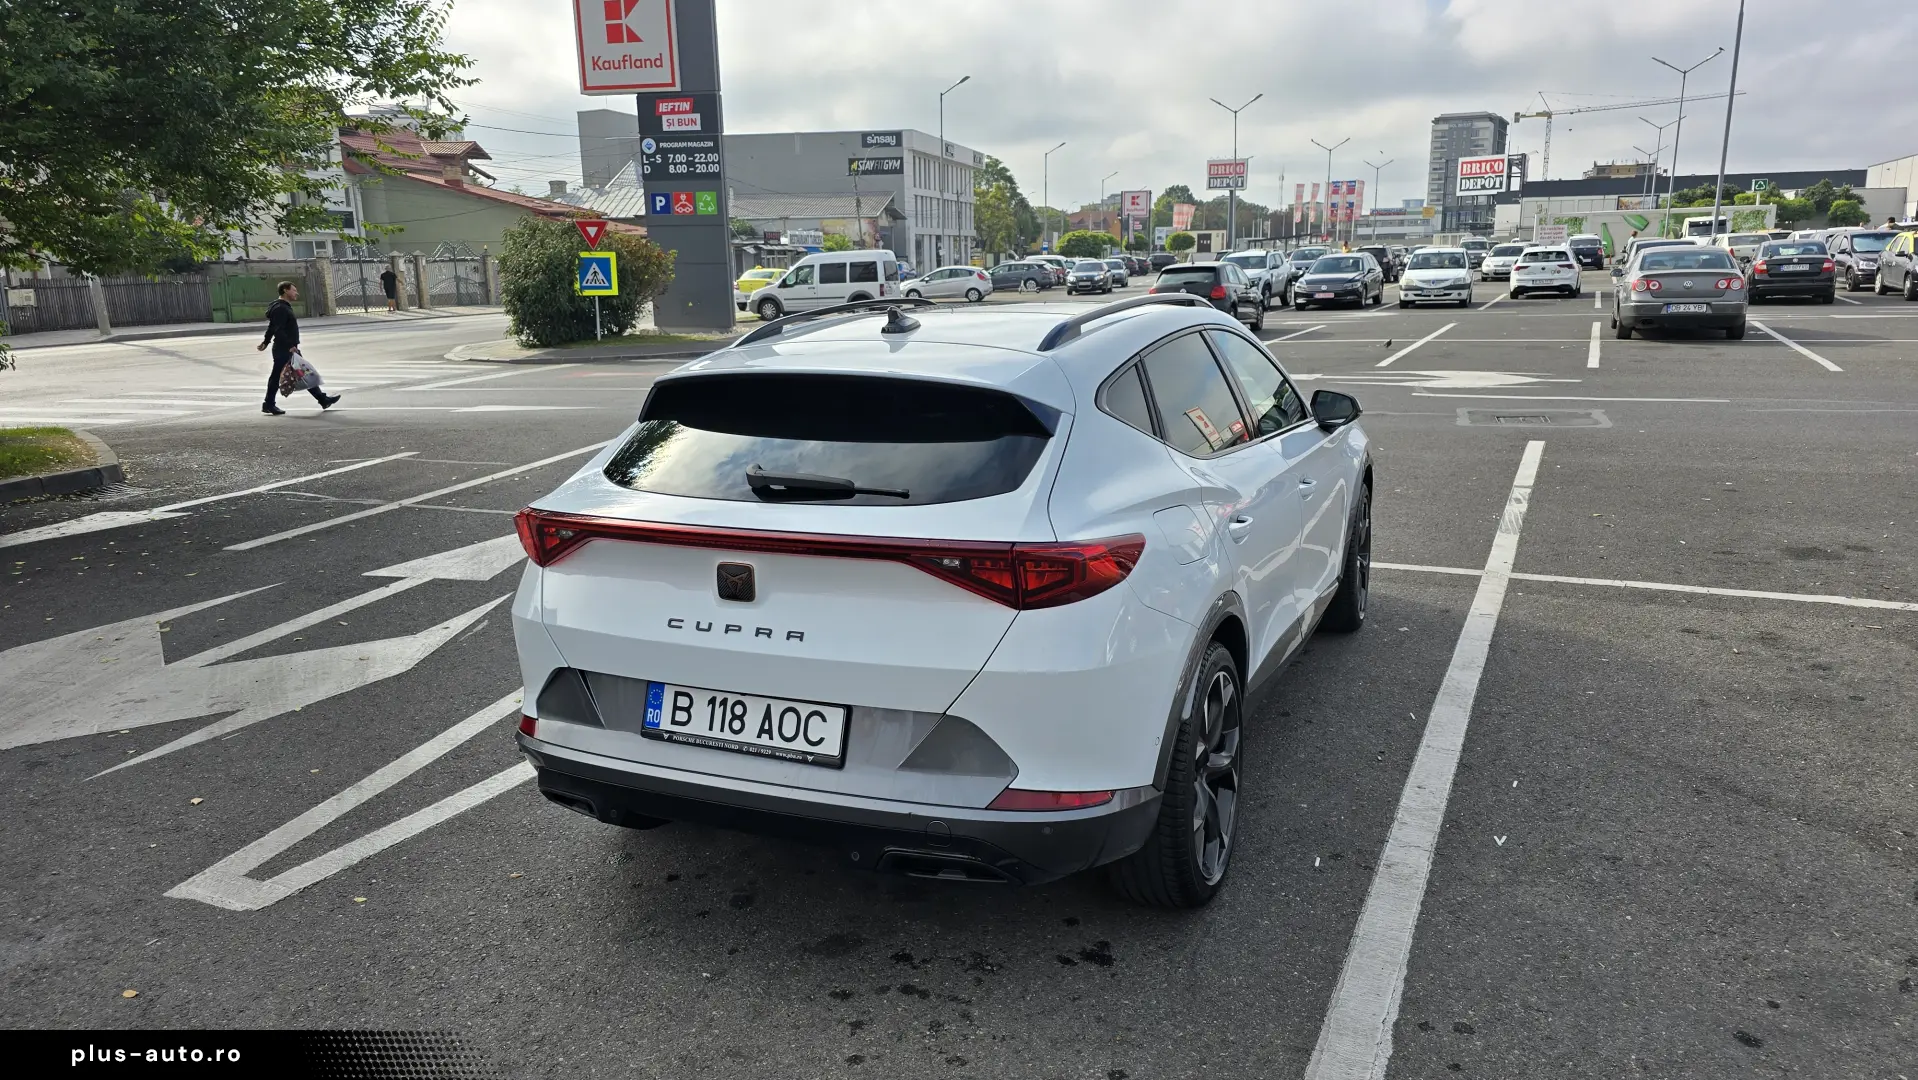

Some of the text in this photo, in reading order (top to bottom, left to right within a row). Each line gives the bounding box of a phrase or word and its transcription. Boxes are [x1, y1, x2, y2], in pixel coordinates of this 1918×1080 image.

[591, 53, 664, 71] Kaufland
[659, 102, 691, 112] IEFTIN
[666, 117, 697, 129] ȘI BUN
[866, 134, 897, 146] sinsay
[643, 166, 651, 174] D
[1210, 163, 1244, 175] BRICO
[1461, 160, 1504, 175] BRICO
[667, 618, 805, 642] CUPRA
[647, 708, 660, 723] RO
[670, 690, 828, 747] B 118 AOC
[724, 742, 739, 750] NORD
